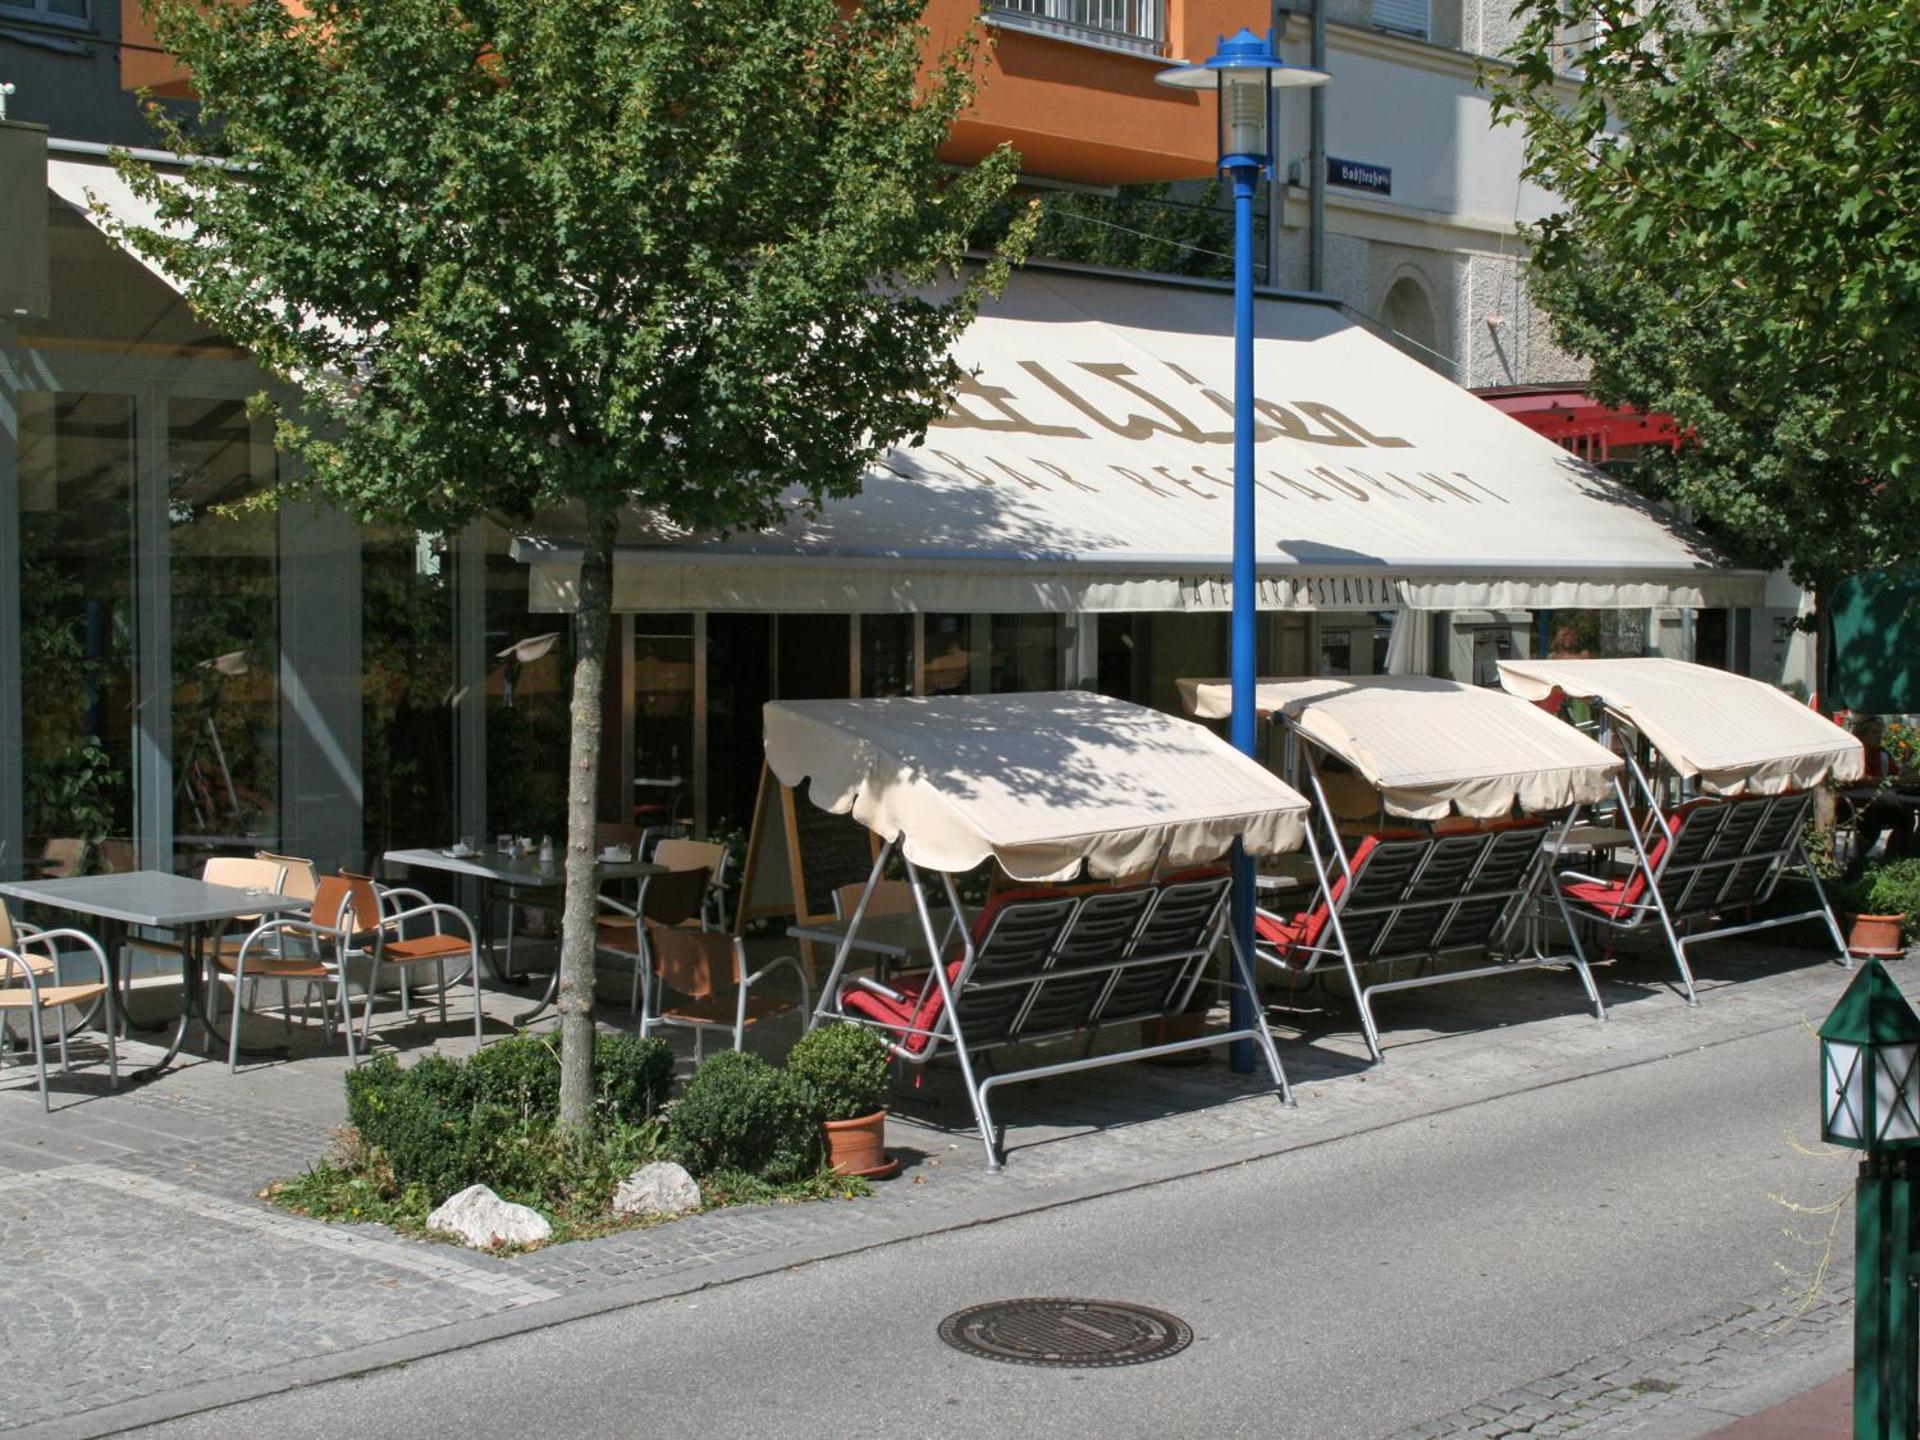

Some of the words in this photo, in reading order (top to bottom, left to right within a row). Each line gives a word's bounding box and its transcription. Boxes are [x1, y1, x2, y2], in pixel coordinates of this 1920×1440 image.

[1342, 166, 1383, 186] Badstraße
[928, 448, 1099, 493] BAR
[1107, 463, 1511, 505] RESTAURANT
[1292, 576, 1415, 605] RESTAURANT
